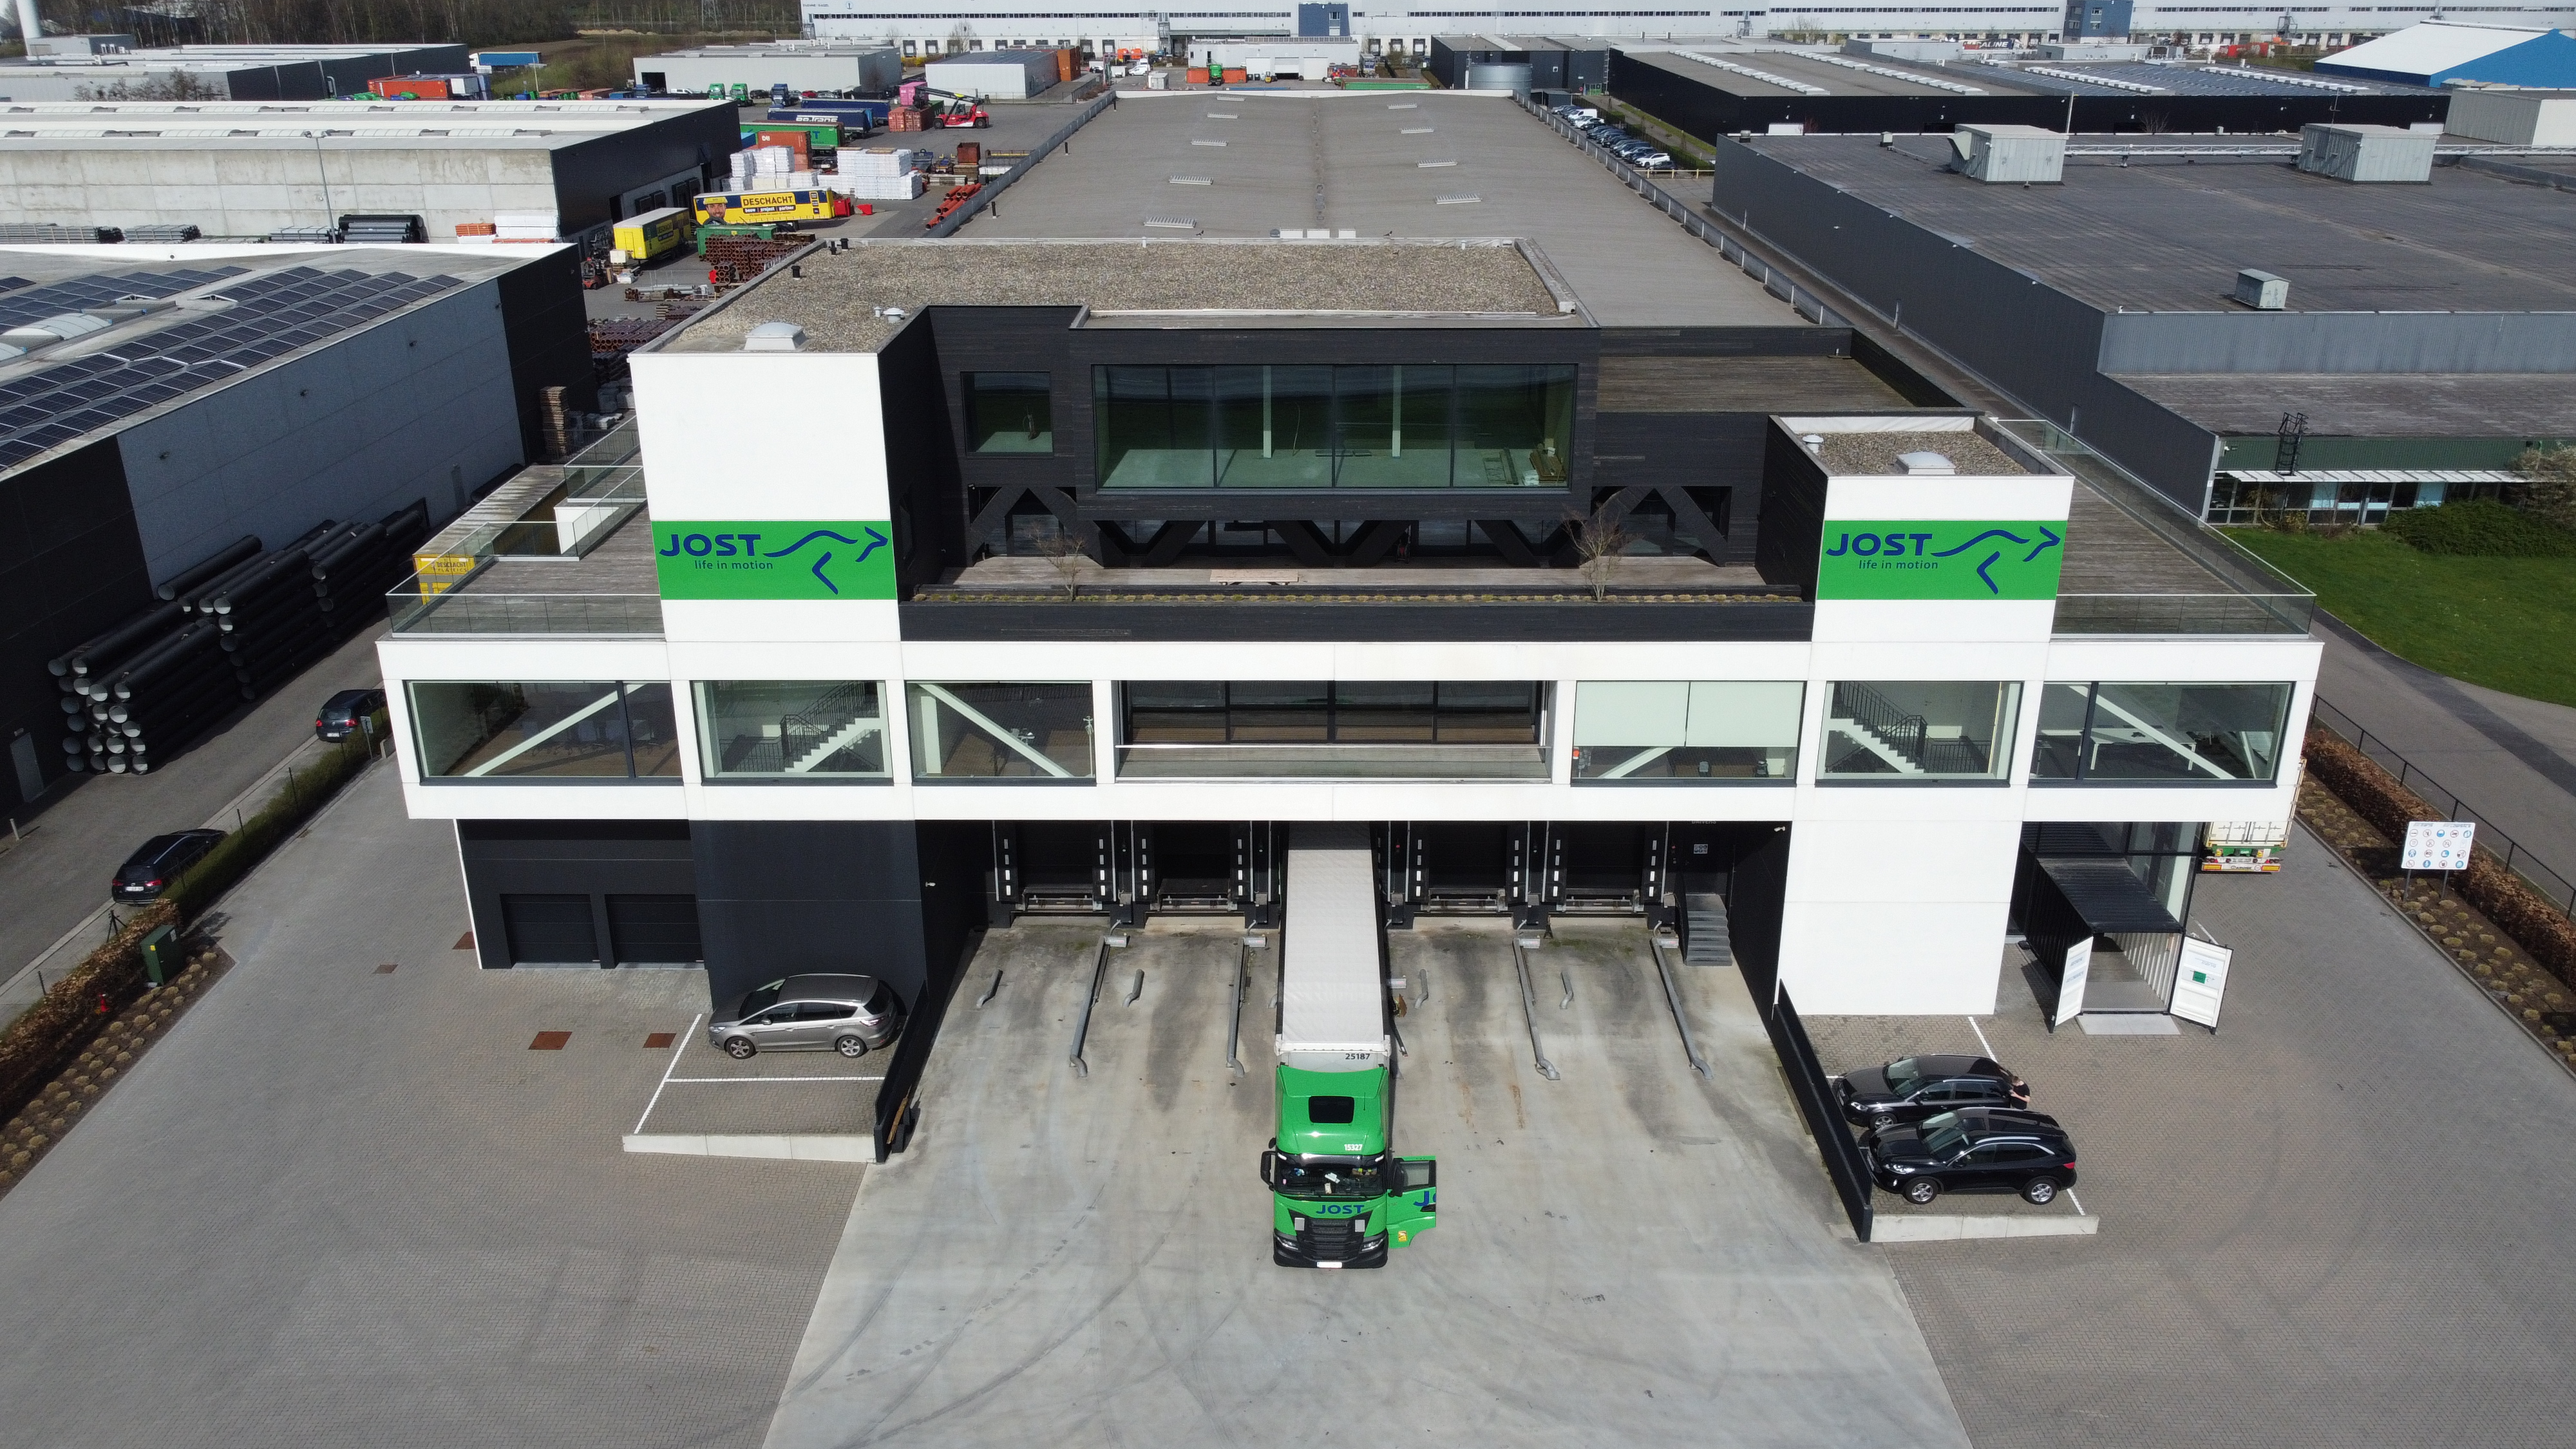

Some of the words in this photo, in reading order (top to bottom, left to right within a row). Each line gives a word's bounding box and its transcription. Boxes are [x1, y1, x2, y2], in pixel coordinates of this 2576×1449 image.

[743, 196, 793, 206] DESCHACHT
[659, 534, 761, 556] JOST
[1826, 533, 1933, 556] JOST
[694, 560, 713, 569] life
[717, 560, 728, 569] in
[732, 560, 773, 569] motion
[1859, 560, 1878, 569] life
[1881, 560, 1892, 569] in
[1896, 560, 1938, 569] motion
[1413, 1190, 1436, 1207] J
[1316, 1205, 1365, 1215] JOST
